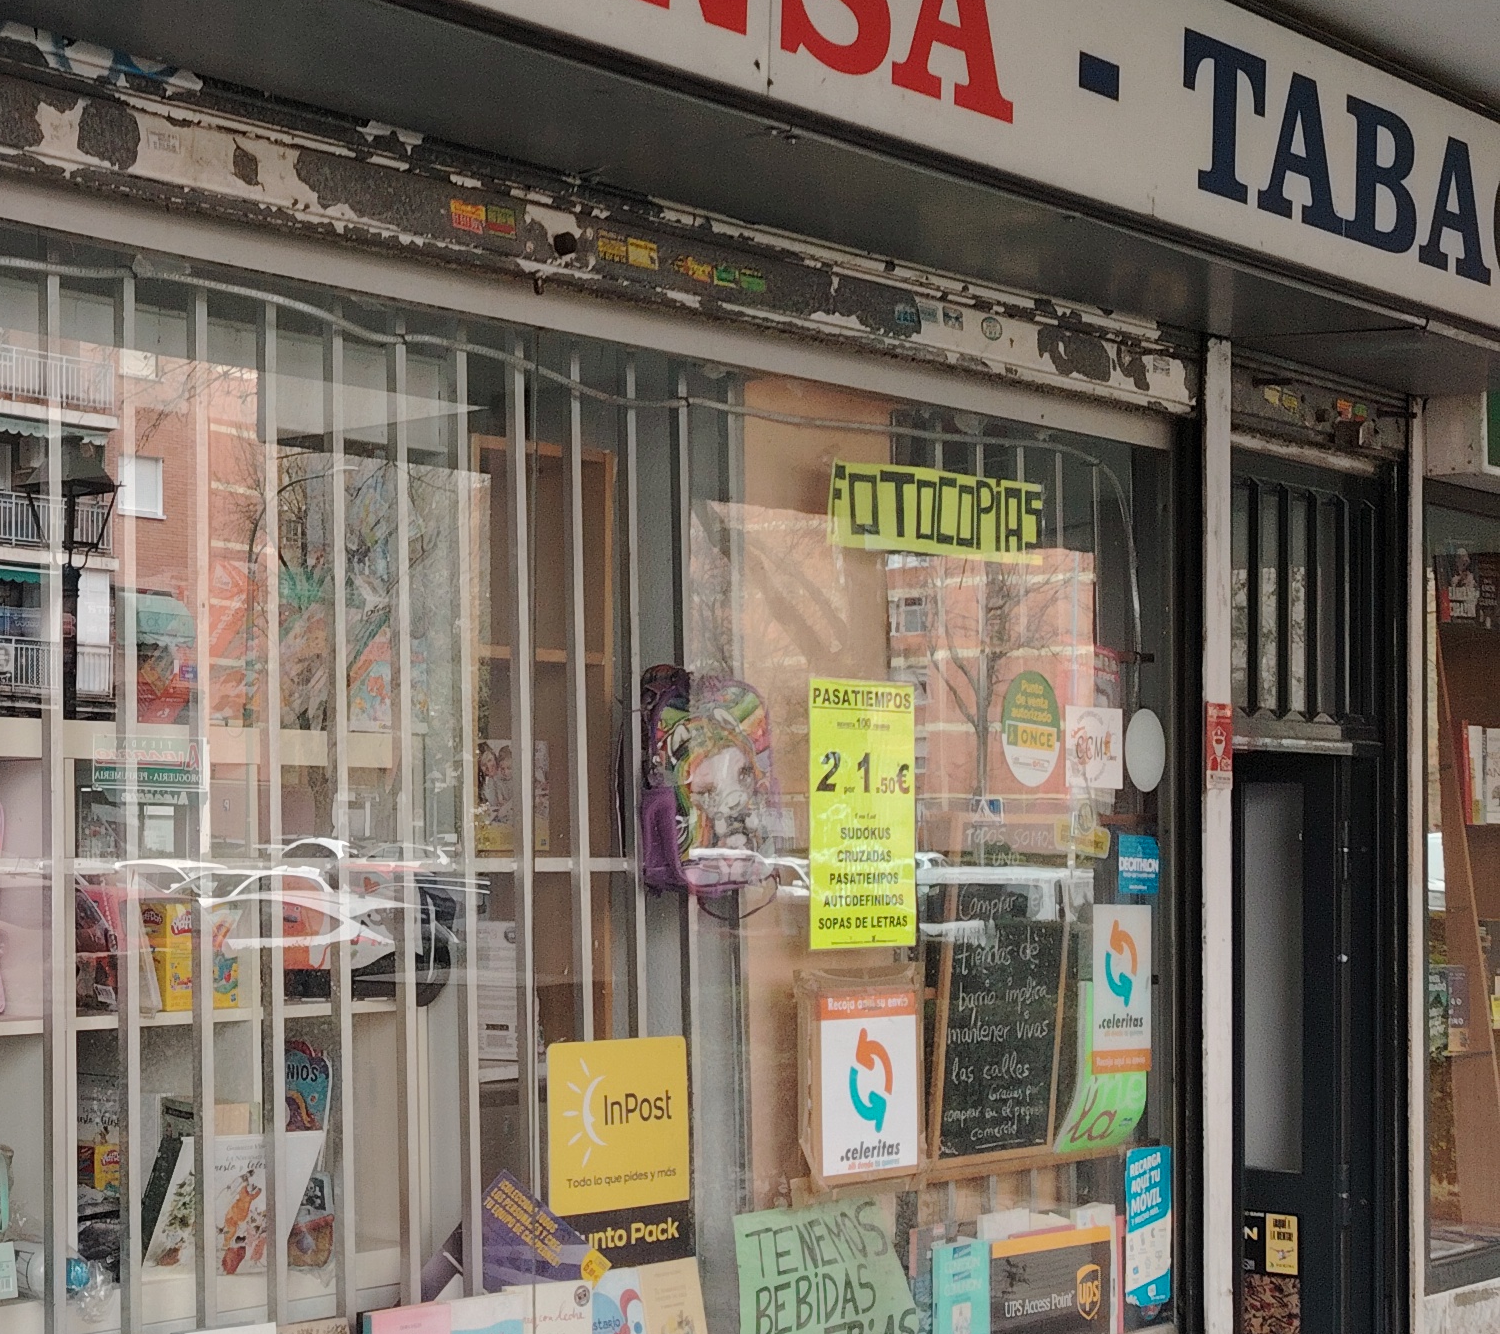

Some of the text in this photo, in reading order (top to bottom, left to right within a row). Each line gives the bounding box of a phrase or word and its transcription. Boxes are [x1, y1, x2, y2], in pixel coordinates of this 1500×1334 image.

[1183, 27, 1500, 286] TABA
[813, 688, 911, 709] PASATIEMPOS
[1021, 680, 1044, 695] Punto
[1015, 694, 1049, 709] de venta
[1011, 707, 1053, 723] autorizado
[1021, 729, 1054, 748] ONCE
[816, 751, 841, 792] 2
[844, 786, 855, 795] por
[837, 850, 892, 863] CRUZADAS
[829, 872, 899, 885] PASATIEMPOS
[823, 894, 904, 908] AUTODEFINIDOS
[818, 915, 908, 930] SOPAS DE LETRAS
[956, 926, 1039, 975] tiendas de
[827, 997, 854, 1013] Recoja
[959, 976, 1051, 1025] barrio implica
[947, 1018, 1010, 1044] mantener
[286, 1064, 319, 1083] NIOS
[952, 1051, 1030, 1084] las calles
[604, 1090, 672, 1126] InPost
[566, 1166, 677, 1189] Todo lo que pides y más
[1130, 1152, 1161, 1178] RECARGA
[1131, 1168, 1160, 1194] AQUÍ TU
[1131, 1186, 1162, 1216] MÓVIL
[583, 1217, 680, 1251] unto Pack
[745, 1201, 888, 1278] TENEMOS
[1004, 1292, 1073, 1318] UPS Access Point
[1079, 1281, 1100, 1311] ups
